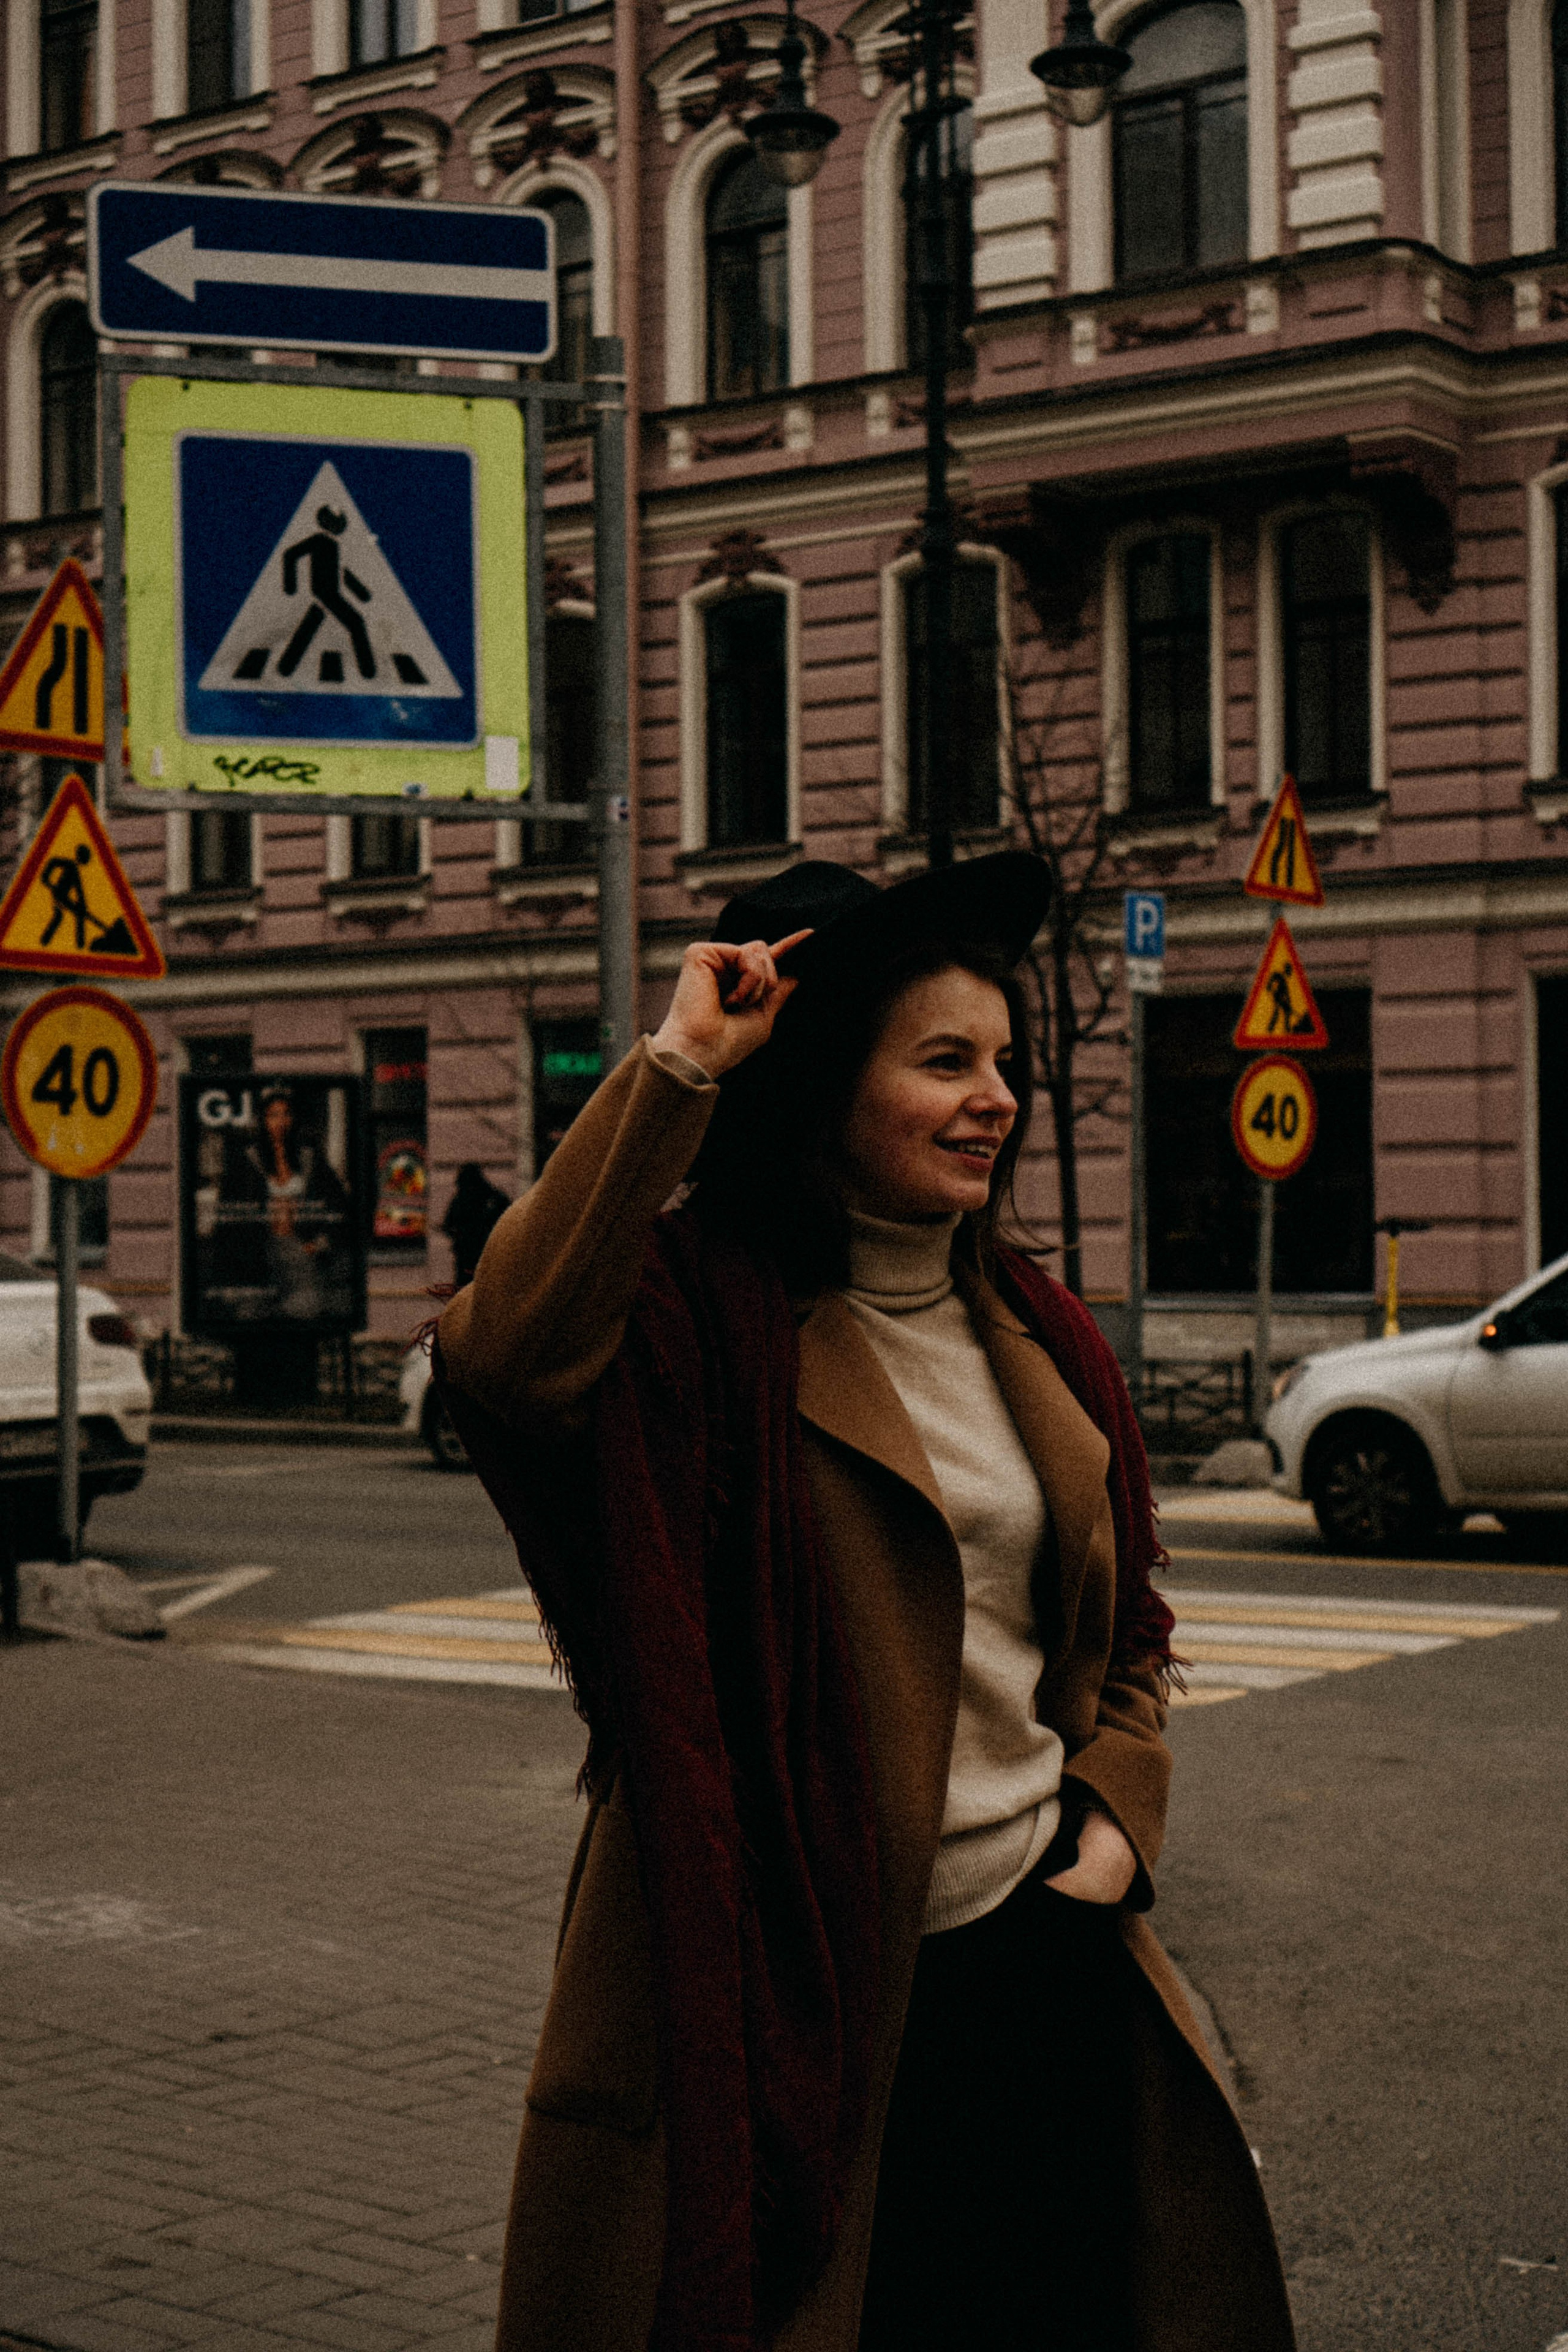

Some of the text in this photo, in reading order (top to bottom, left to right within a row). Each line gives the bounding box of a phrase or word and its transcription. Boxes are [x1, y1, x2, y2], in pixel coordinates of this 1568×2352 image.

[1135, 900, 1159, 950] P
[32, 1045, 119, 1117] 40
[1251, 1094, 1299, 1139] 40
